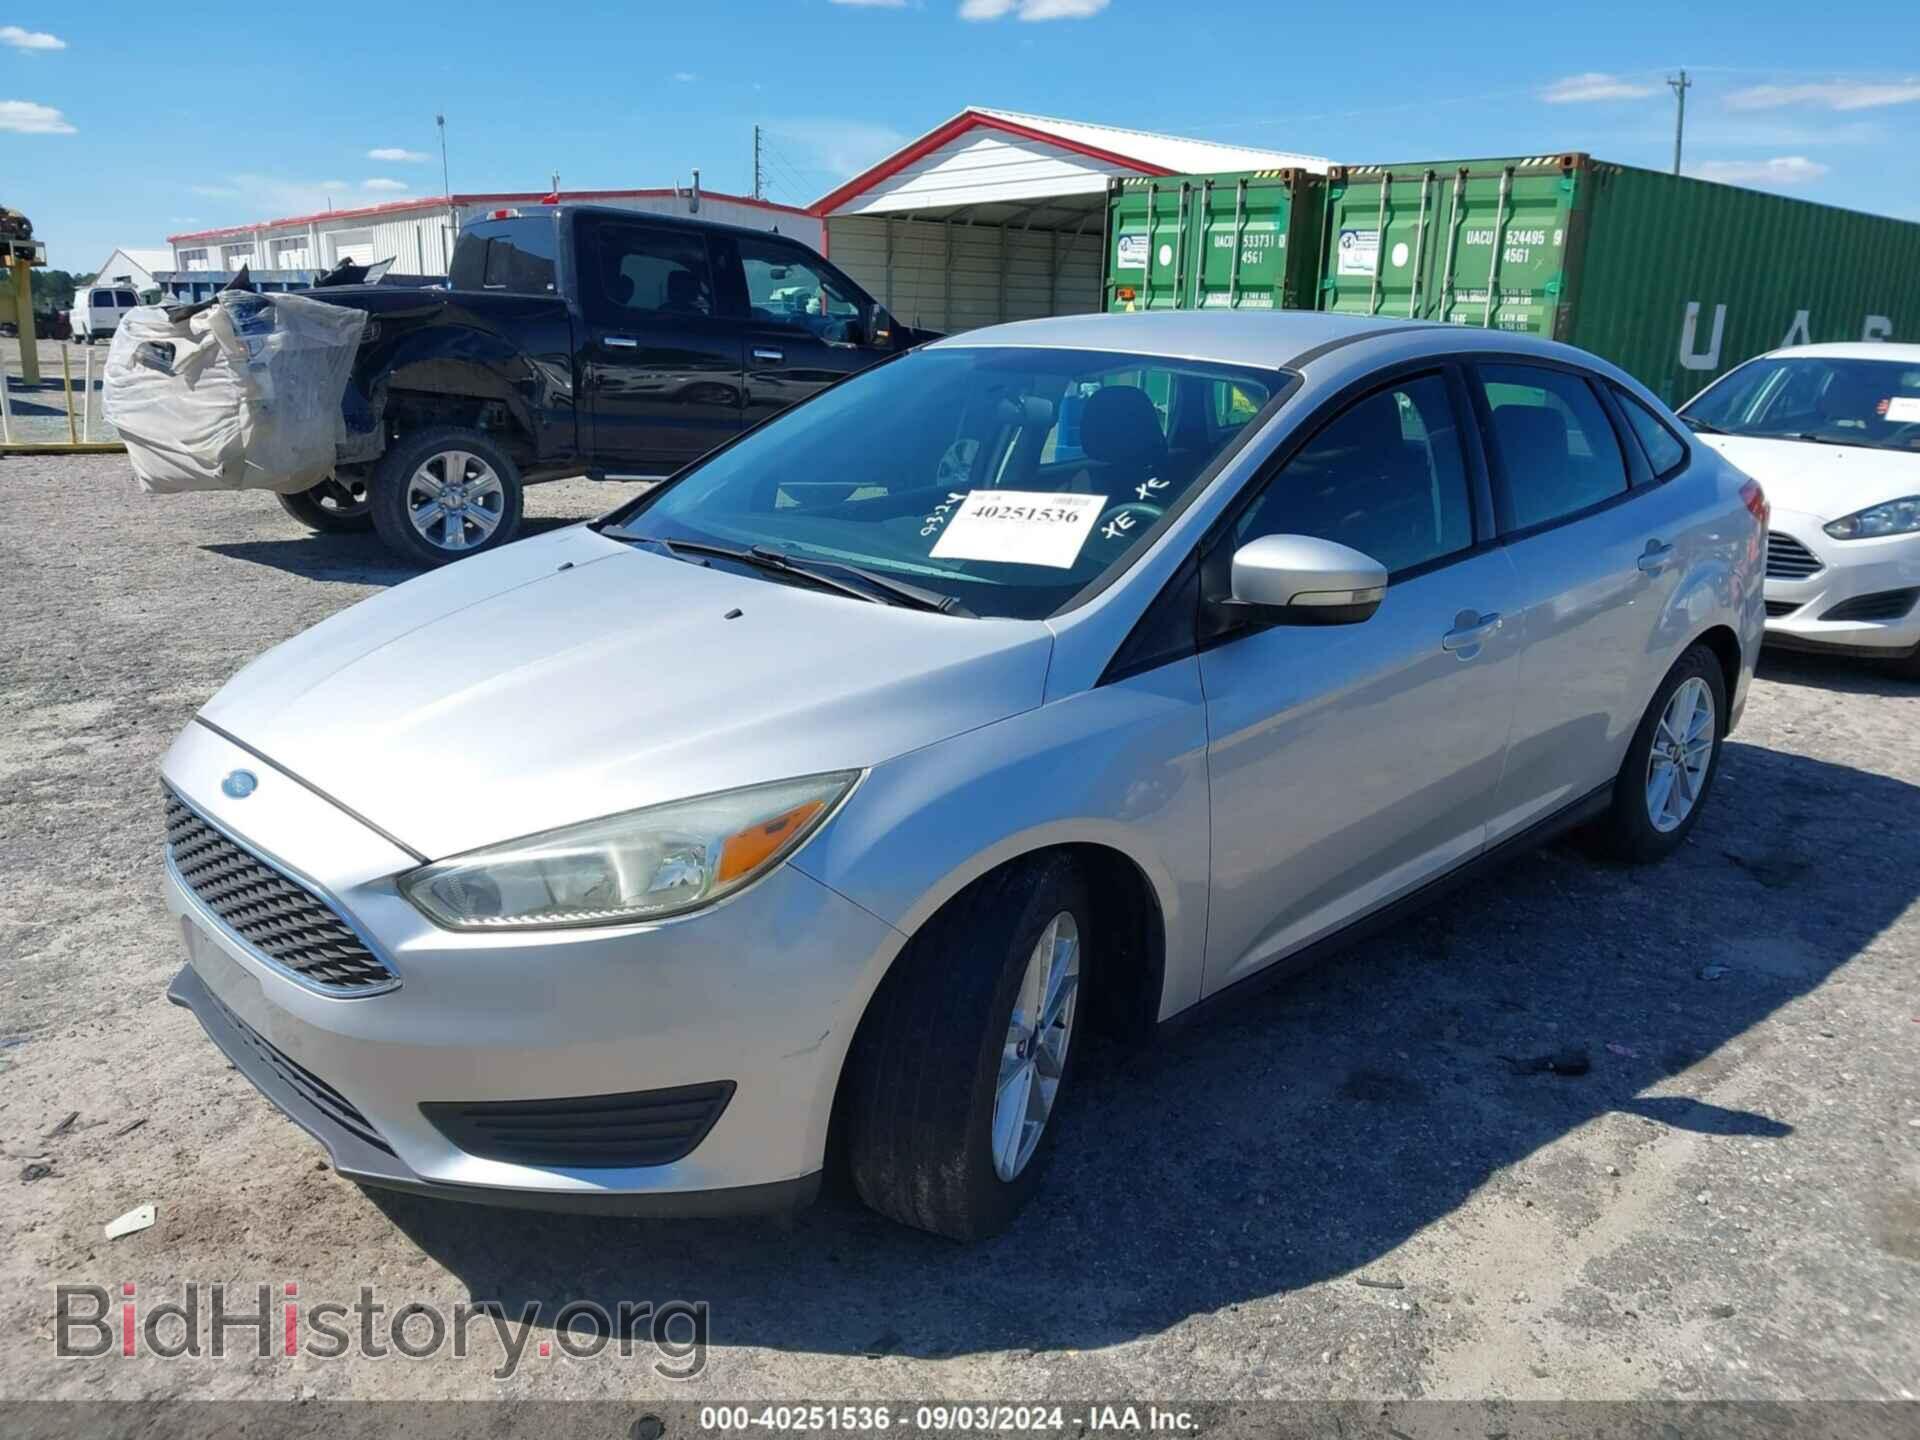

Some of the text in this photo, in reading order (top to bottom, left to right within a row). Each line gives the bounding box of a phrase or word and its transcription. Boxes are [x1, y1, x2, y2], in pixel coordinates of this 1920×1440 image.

[1243, 234, 1274, 248] 533731
[1465, 230, 1494, 245] UACU
[1506, 230, 1545, 245] 524495
[1135, 477, 1170, 500] XE
[971, 505, 1080, 524] 40251536
[1101, 510, 1137, 540] XE
